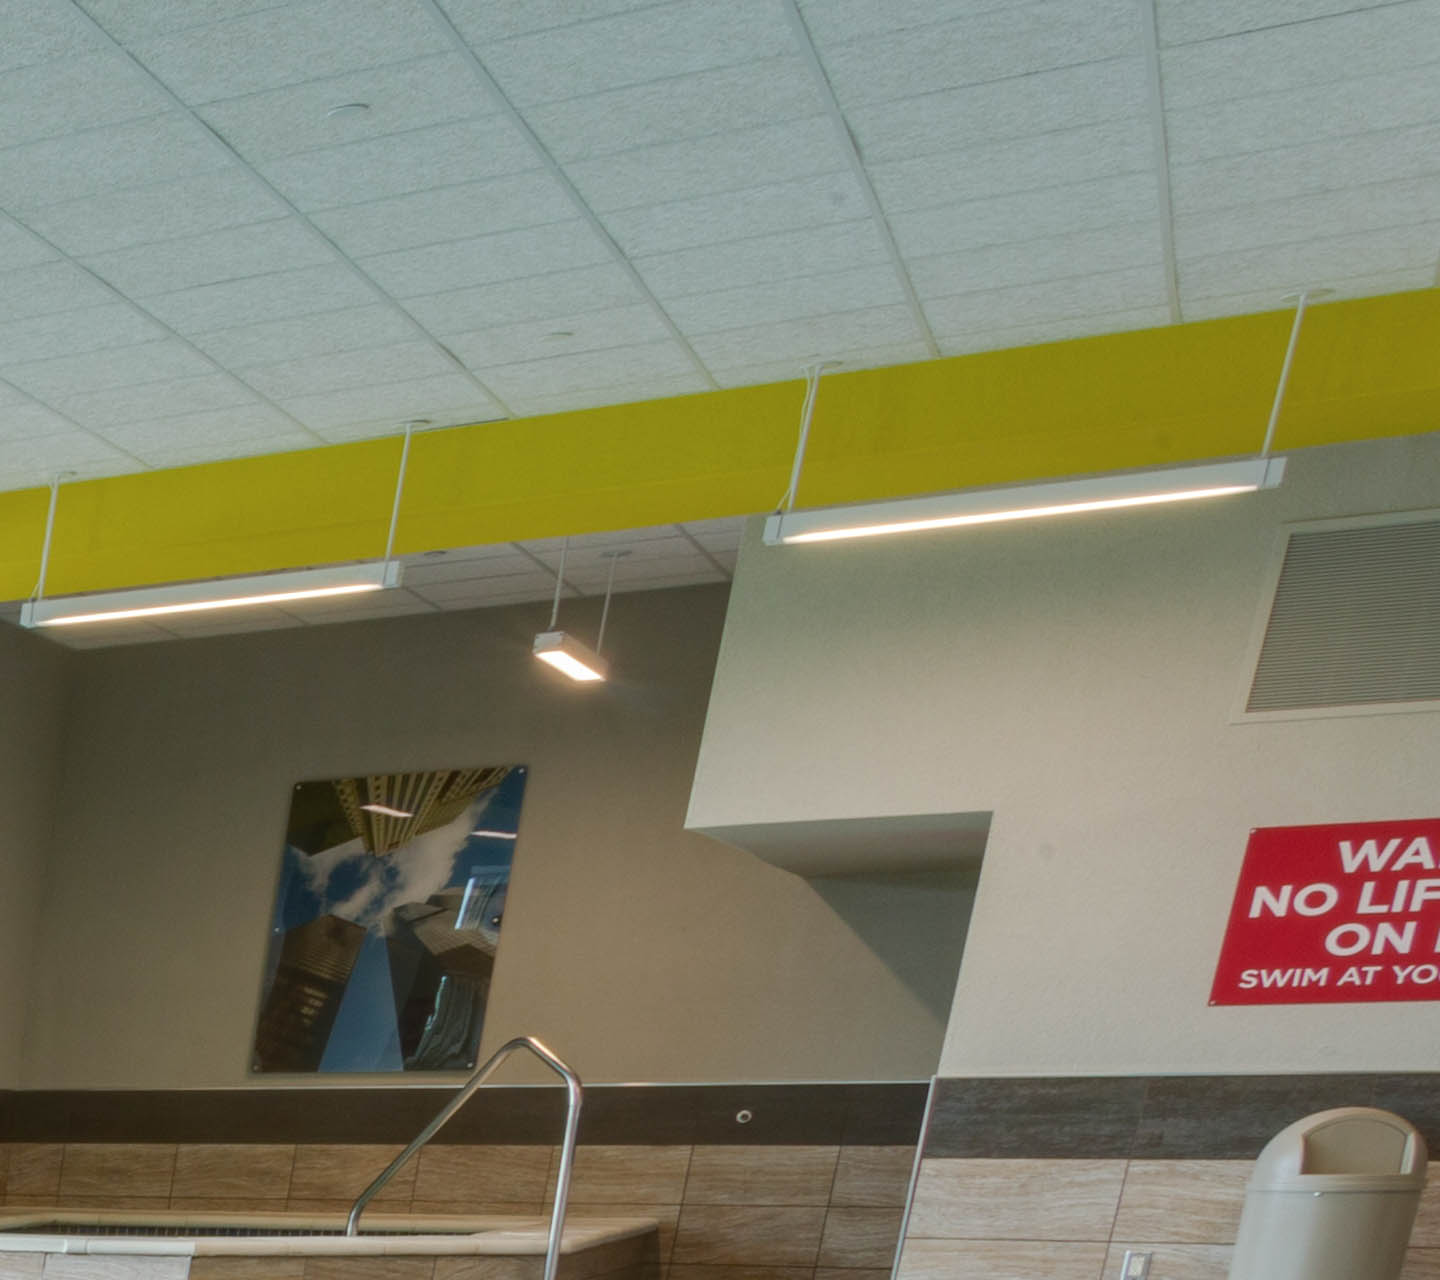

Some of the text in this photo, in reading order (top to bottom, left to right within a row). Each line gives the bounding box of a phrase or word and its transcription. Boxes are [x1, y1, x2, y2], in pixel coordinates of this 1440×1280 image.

[1338, 836, 1440, 874] WA
[1248, 882, 1339, 919] NO
[1324, 921, 1417, 957] ON
[1237, 963, 1440, 989] SWIM AT YO
